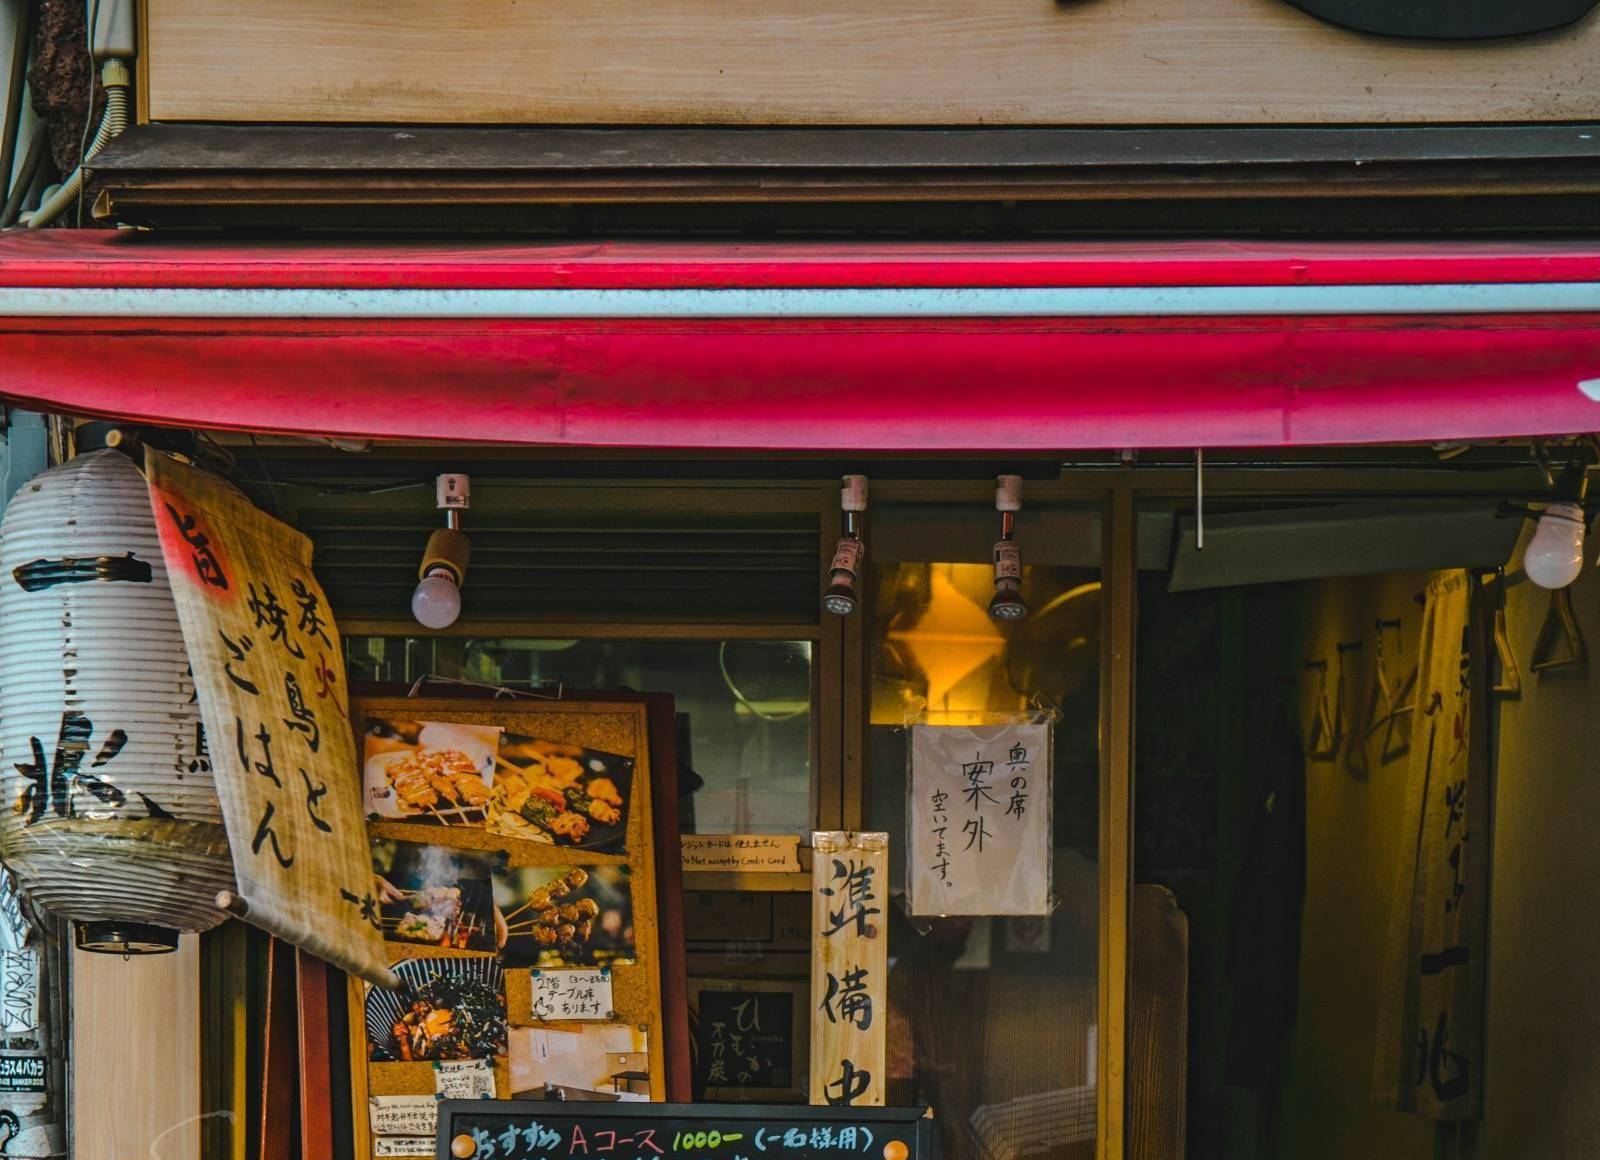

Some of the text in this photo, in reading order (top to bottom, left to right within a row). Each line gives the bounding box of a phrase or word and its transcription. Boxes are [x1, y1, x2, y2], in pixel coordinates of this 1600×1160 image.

[219, 629, 294, 869] ごはん
[561, 1001, 602, 1015] あります
[819, 858, 882, 1106] 準備中
[472, 1121, 562, 1160] おすすめ
